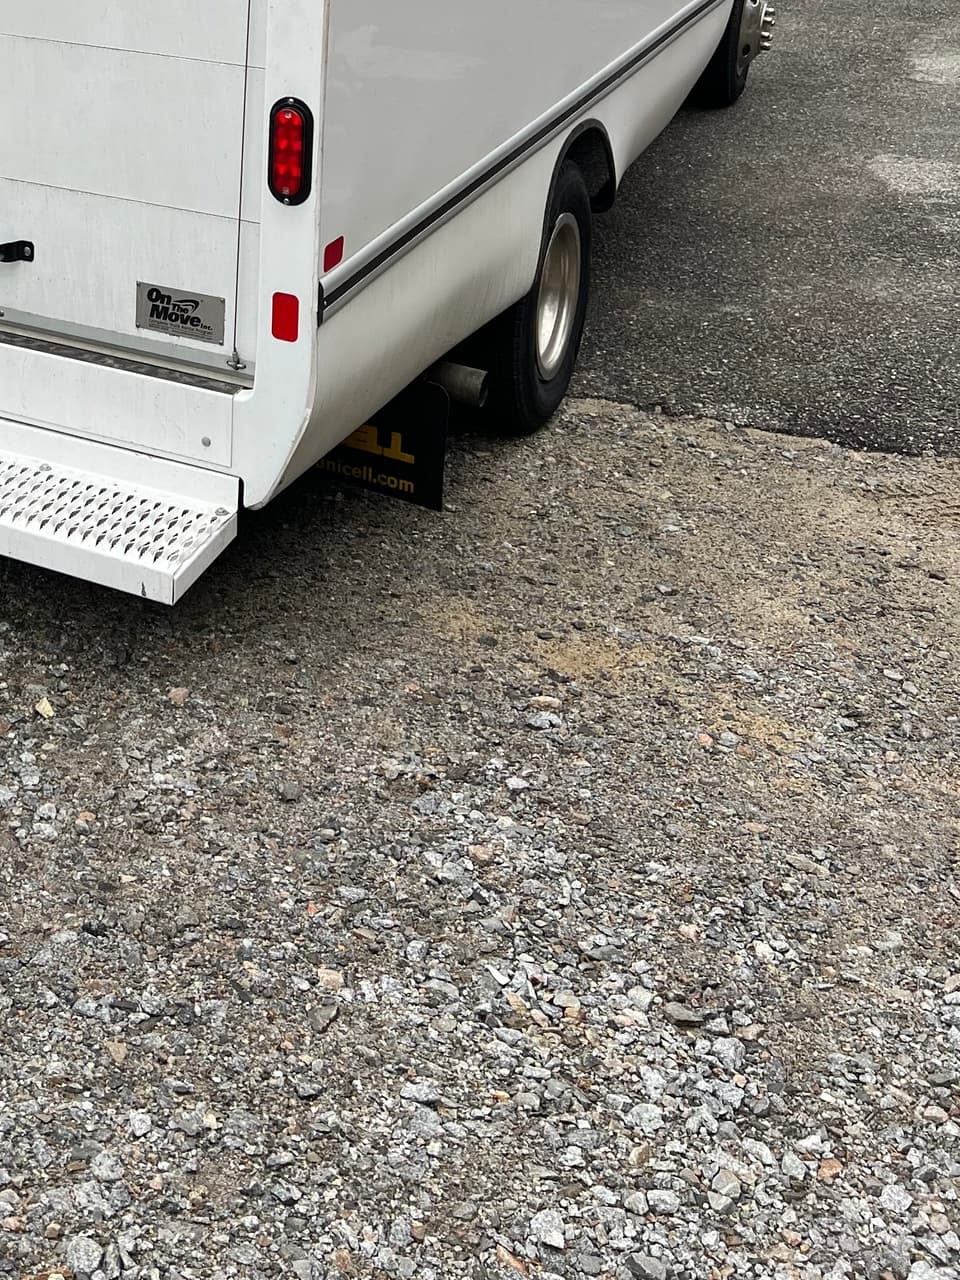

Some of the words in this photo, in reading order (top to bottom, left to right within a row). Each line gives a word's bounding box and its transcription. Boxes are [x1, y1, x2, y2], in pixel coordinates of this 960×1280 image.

[147, 287, 172, 305] On
[171, 303, 189, 314] The
[149, 303, 202, 327] Move
